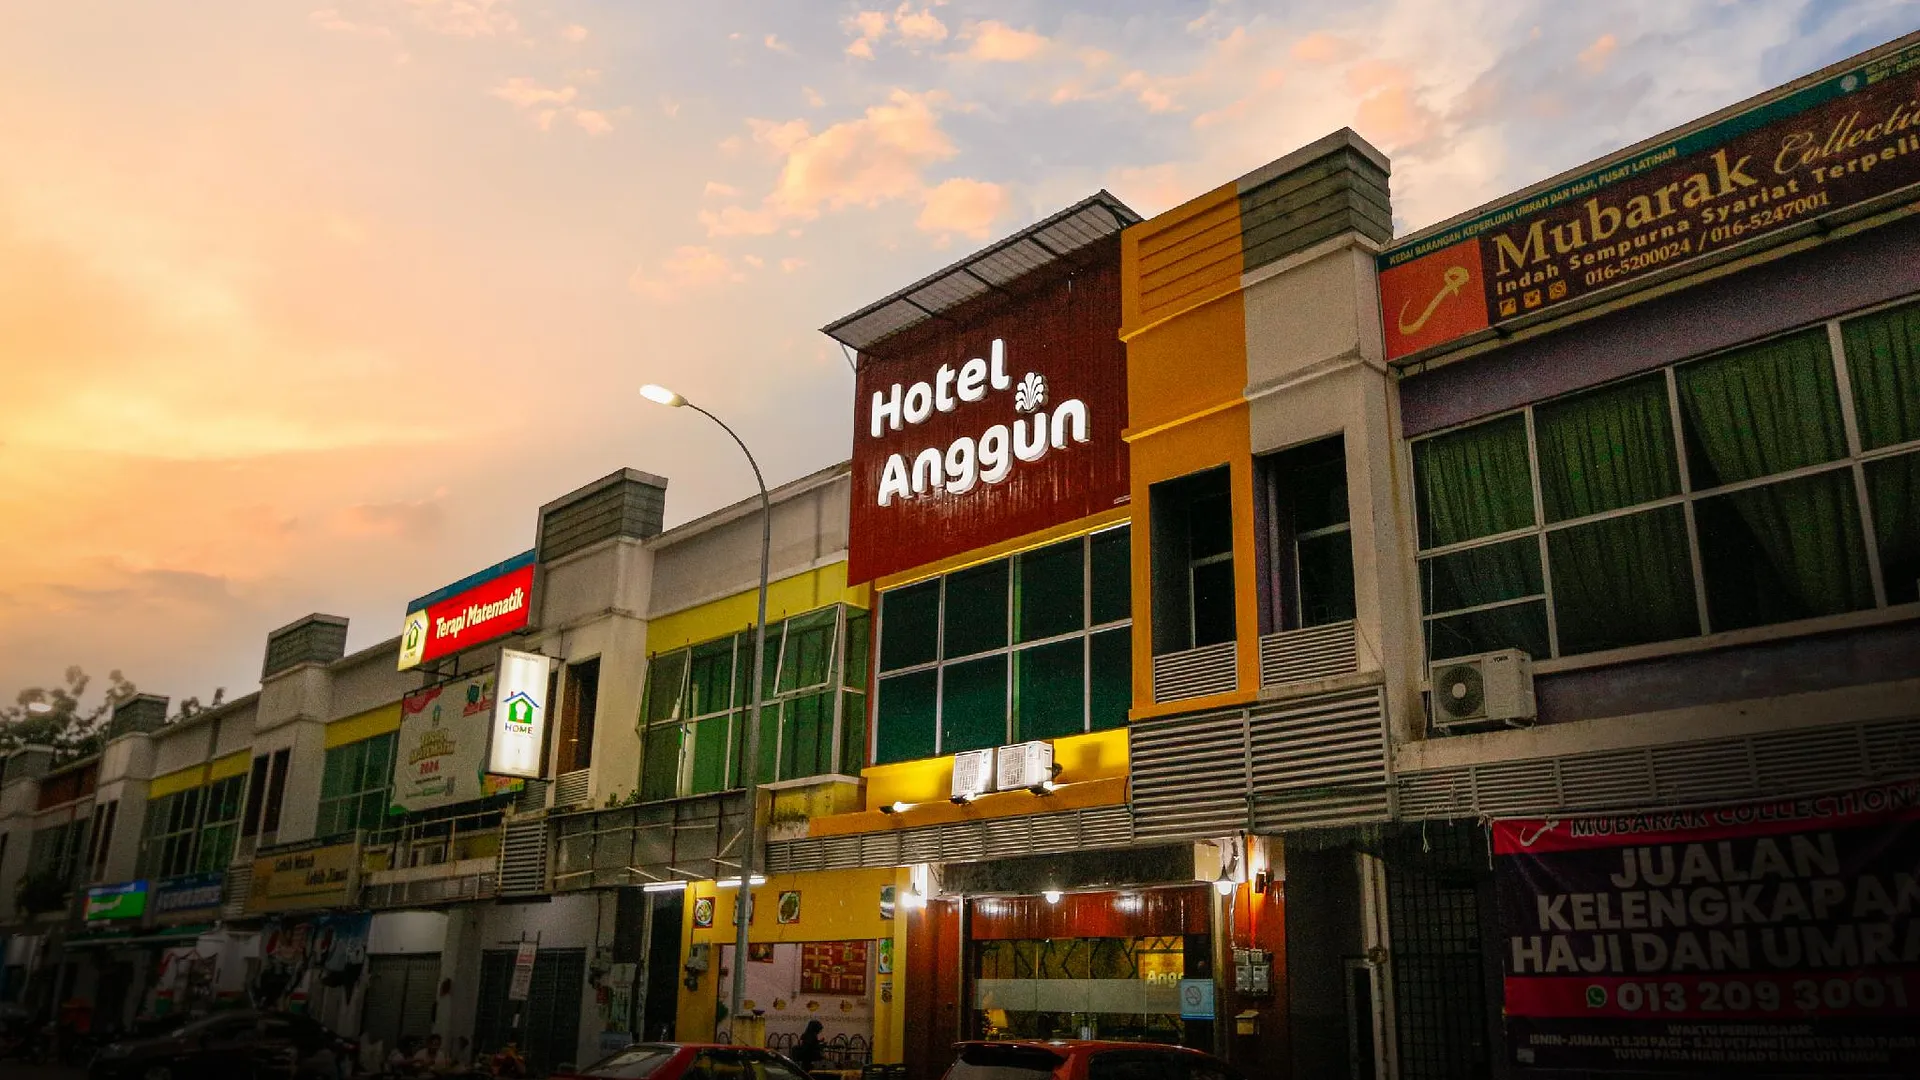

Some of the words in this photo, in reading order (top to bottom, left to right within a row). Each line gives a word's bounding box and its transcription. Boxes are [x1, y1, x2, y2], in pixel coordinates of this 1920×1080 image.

[1389, 250, 1414, 266] KEDAI
[1415, 231, 1461, 256] BARANGAN
[1463, 211, 1514, 238] KEPERLUAN
[1515, 197, 1549, 217] UMRAH
[1551, 191, 1570, 205] DAN
[1598, 166, 1630, 186] PUSAT
[1631, 147, 1677, 175] LATIHAN
[1492, 148, 1758, 277] Mubarak
[1496, 264, 1560, 296] Indah
[1569, 217, 1690, 275] Sempurna
[1701, 178, 1800, 226] Syariat
[1585, 238, 1693, 287] 016-5200024
[1710, 190, 1831, 244] 016-5247001
[871, 338, 1012, 438] Hotel
[877, 398, 1091, 507] Anggun
[436, 608, 467, 640] Terapi
[467, 587, 525, 628] Matematik
[504, 722, 533, 736] HOME
[1570, 811, 1708, 839] MUBARAK
[1715, 784, 1912, 826] COLLECTION
[1610, 832, 1840, 889] JUALAN
[1510, 933, 1623, 973] HAJI
[1633, 928, 1750, 973] DAN
[1616, 981, 1688, 1013] 013
[1700, 979, 1780, 1012] 209
[1793, 973, 1908, 1012] 3001
